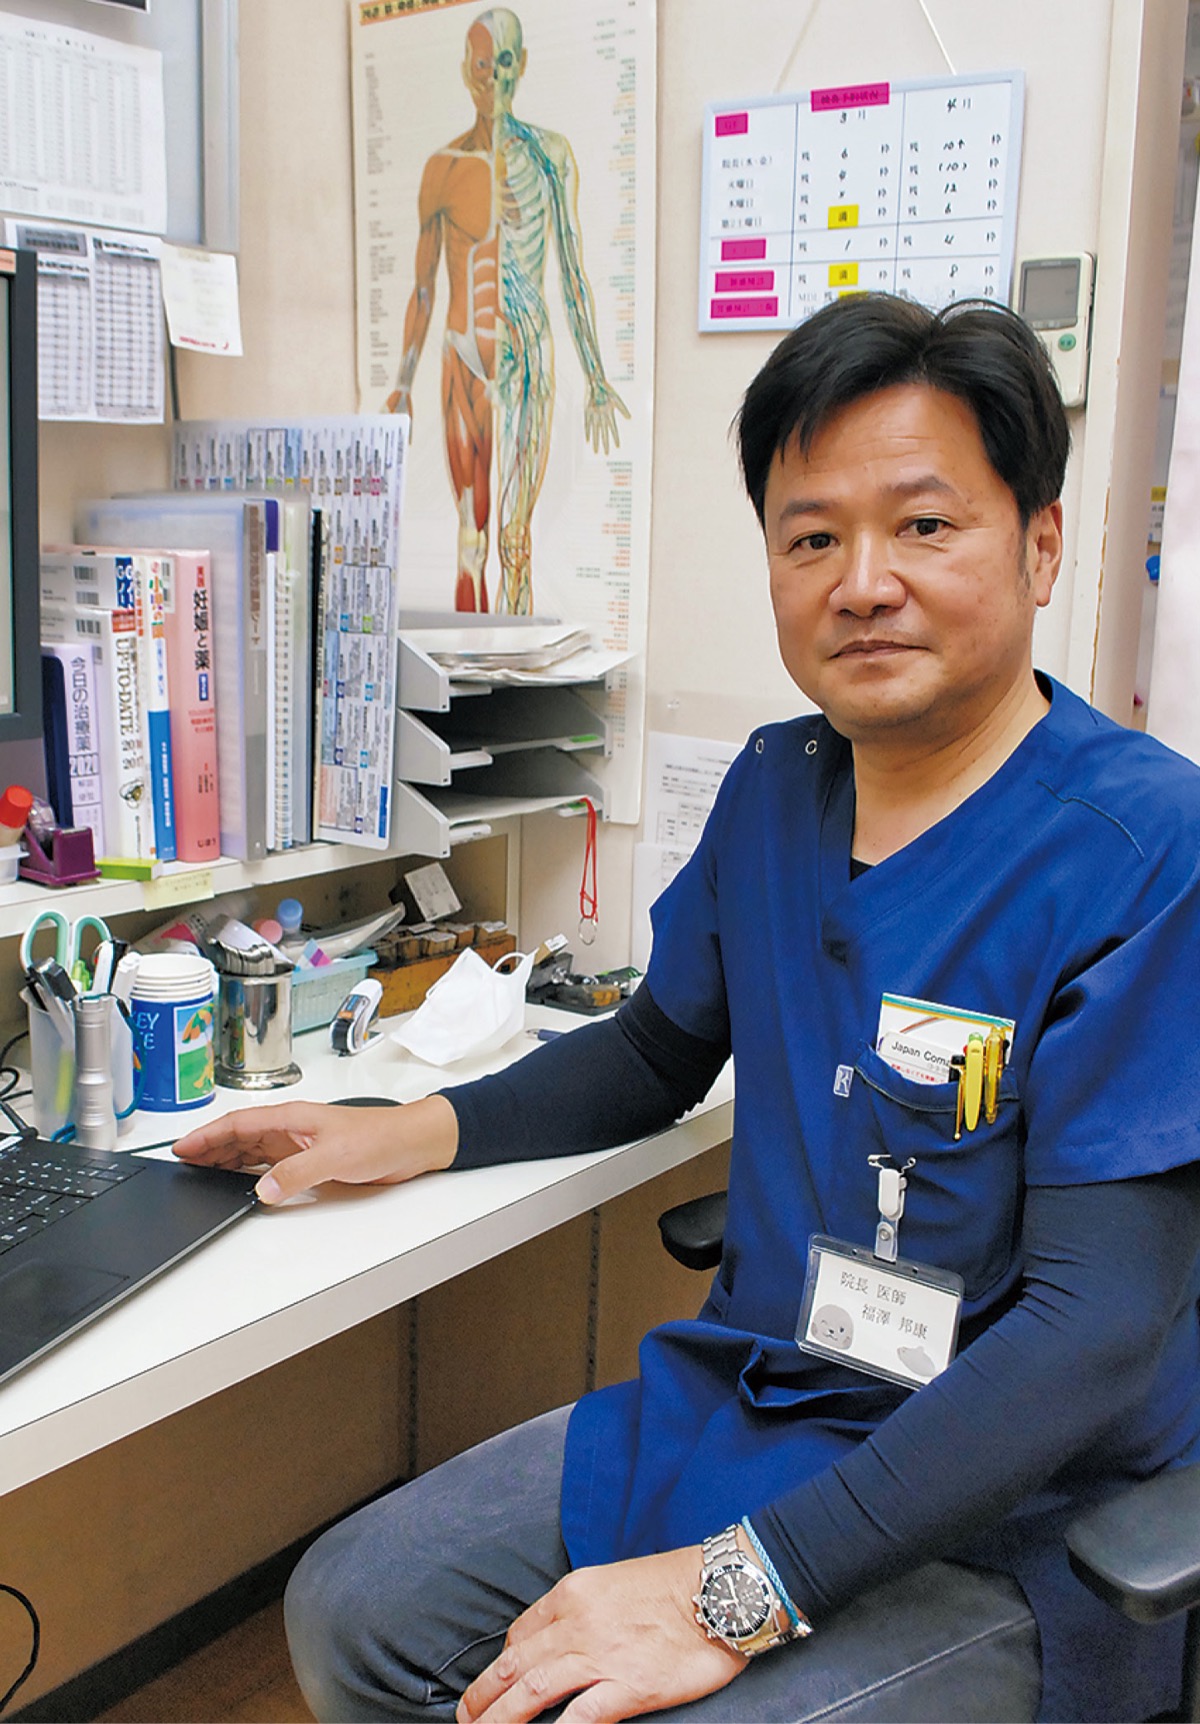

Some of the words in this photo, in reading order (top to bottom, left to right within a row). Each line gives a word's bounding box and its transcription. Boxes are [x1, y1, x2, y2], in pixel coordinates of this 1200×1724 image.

[71, 655, 92, 752] 今日の治療薬
[891, 1041, 921, 1058] Japan
[841, 1271, 869, 1295] 院長
[876, 1283, 907, 1306] 医師
